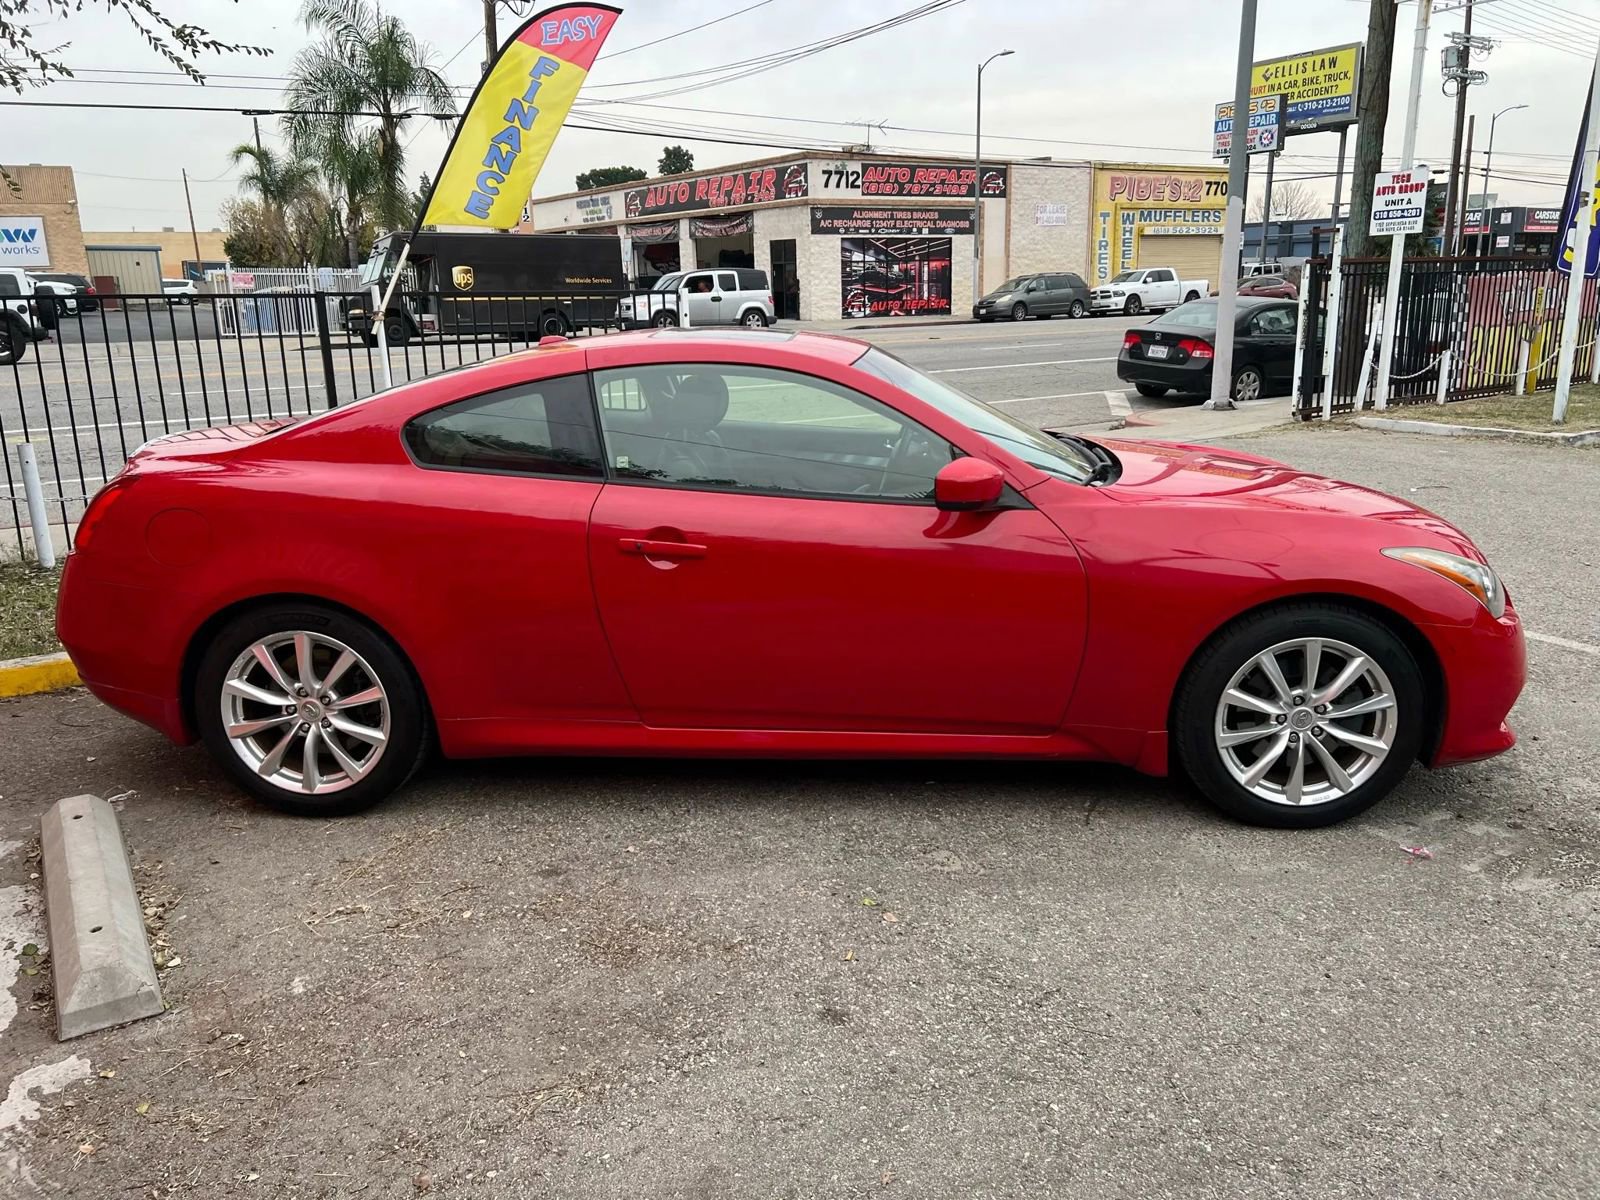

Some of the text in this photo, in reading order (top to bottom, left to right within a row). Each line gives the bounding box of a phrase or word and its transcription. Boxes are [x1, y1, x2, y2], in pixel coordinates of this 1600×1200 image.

[541, 15, 603, 46] EASY
[1274, 56, 1338, 78] ELLIS LAW
[1267, 83, 1275, 92] IN
[1276, 82, 1282, 92] A
[1283, 79, 1300, 90] CAR,
[1302, 75, 1322, 87] BIKE,
[1323, 71, 1351, 83] TRUCK,
[1296, 84, 1339, 100] ACCIDENT?
[1304, 96, 1350, 111] 310-213-2100
[1216, 113, 1276, 132] AUT EPAIR
[464, 56, 560, 219] FINANCE
[821, 169, 861, 190] 7712
[863, 167, 976, 184] AUTO REPAIR
[1391, 173, 1411, 184] TECH
[644, 181, 690, 208] AUTO
[695, 168, 777, 201] REPAIR
[863, 182, 968, 196] (818) 787-3492
[1109, 175, 1182, 202] PIBE'S
[1376, 182, 1425, 196] AUTO GROUP
[1384, 199, 1404, 207] UNIT
[852, 210, 939, 219] ALIGNMENT TIRES BRAKES
[1138, 210, 1222, 223] MUFFLERS
[1375, 208, 1420, 219] 310 650-4201
[1534, 210, 1560, 220] CARSTAR
[819, 219, 970, 228] A/C RECHARGE 1234YF ELECTRICAL DIAGNOSIS
[1097, 211, 1111, 280] TIRES
[1120, 212, 1136, 272] WHEEL
[1, 245, 40, 255] works
[454, 273, 473, 287] ups
[870, 300, 901, 311] AUTO
